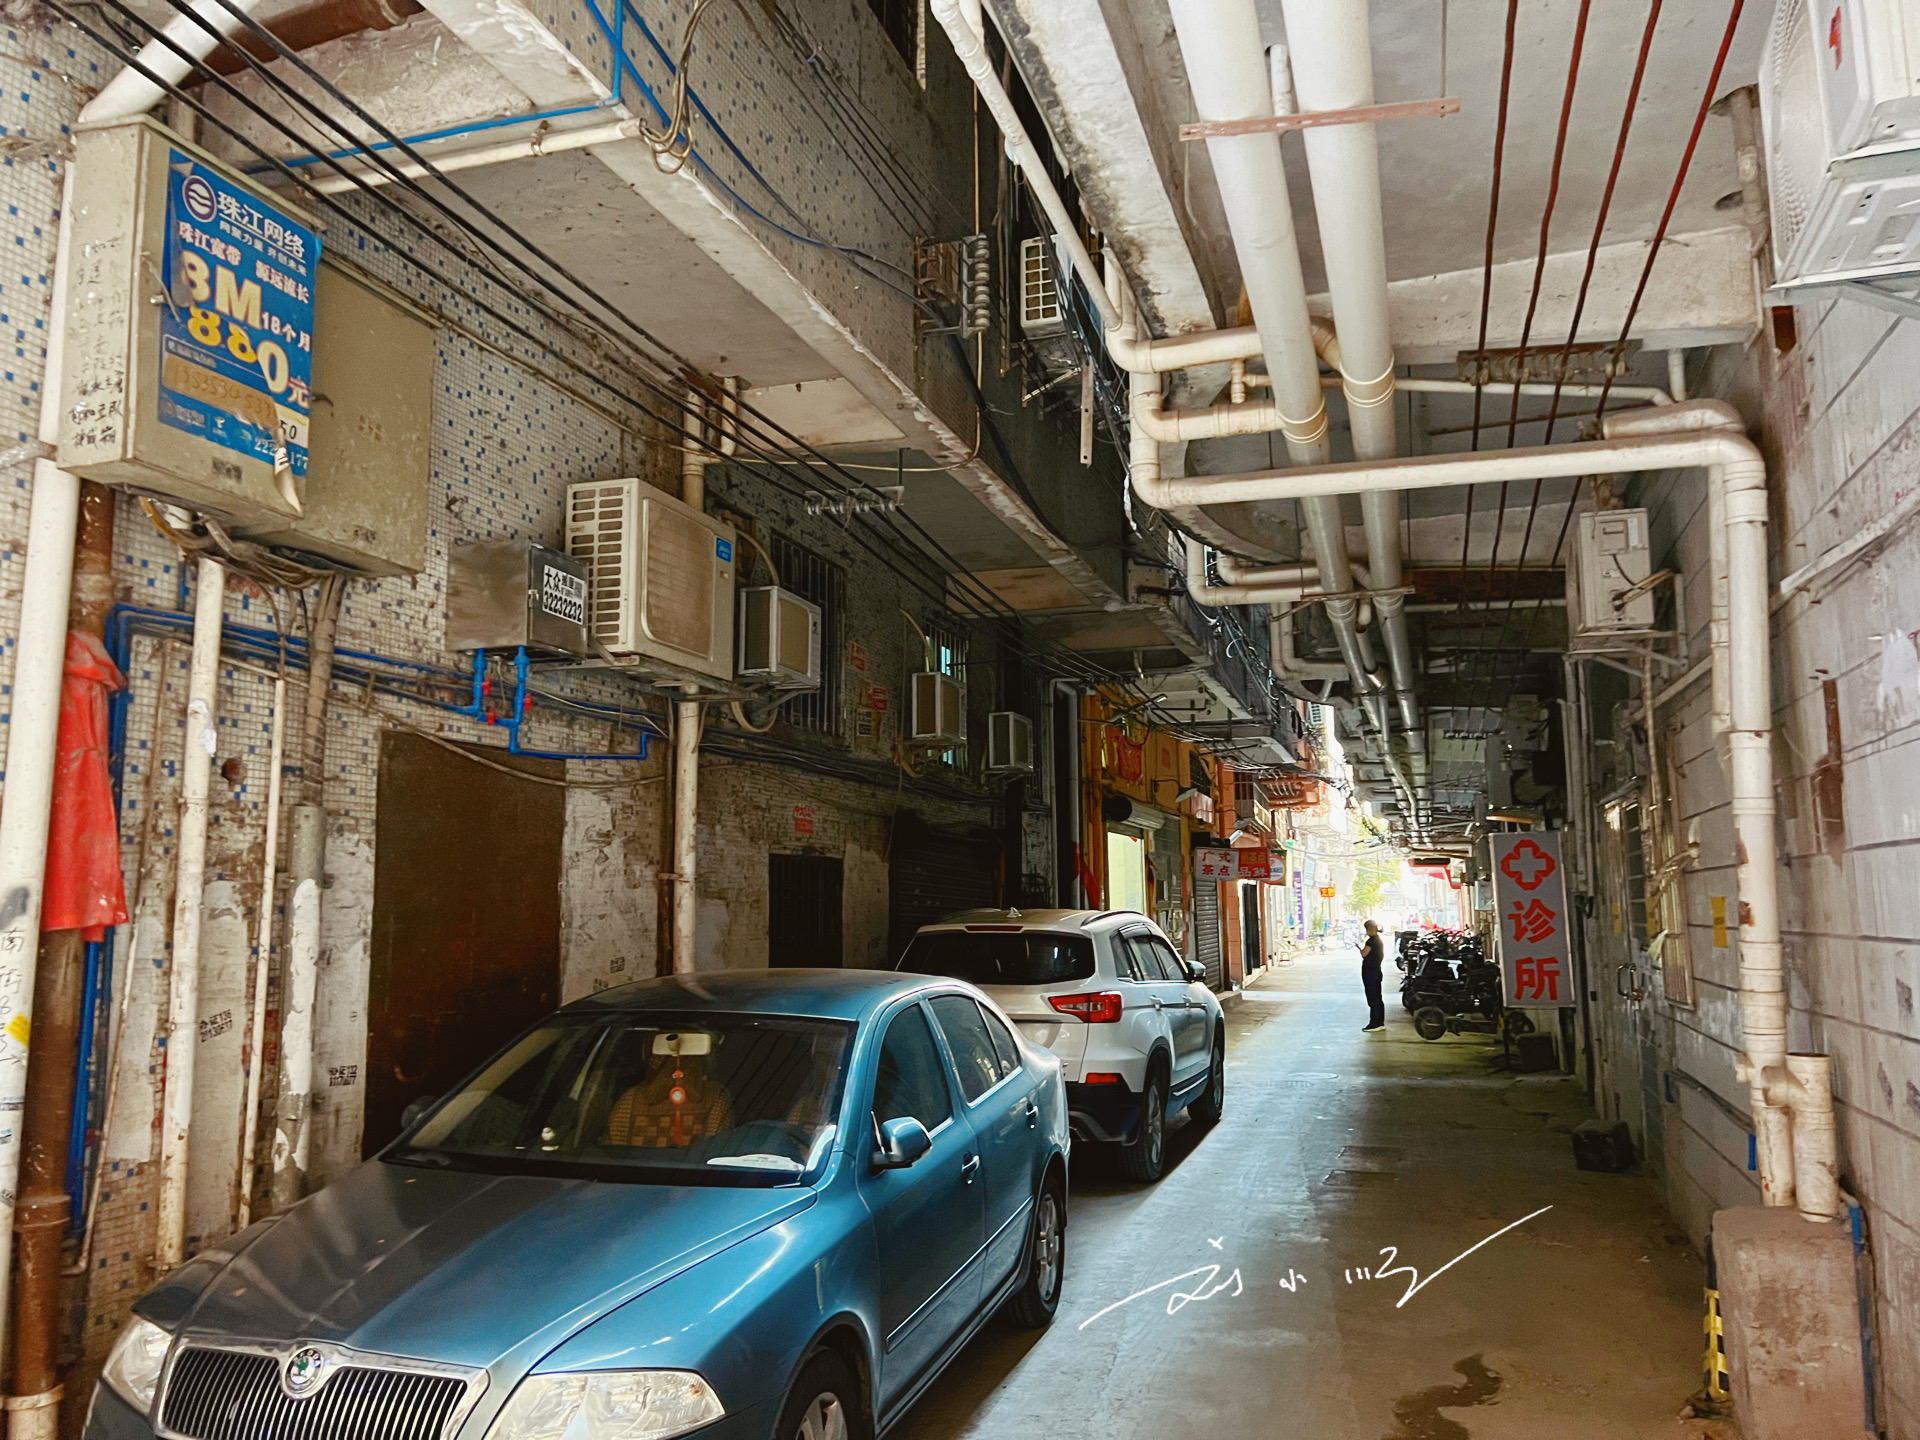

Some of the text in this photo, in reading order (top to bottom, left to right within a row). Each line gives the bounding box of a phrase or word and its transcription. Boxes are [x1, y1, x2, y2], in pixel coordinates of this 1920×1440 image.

[217, 191, 305, 258] 珠江网络
[1202, 851, 1231, 863] 广式
[1202, 864, 1231, 877] 茶点
[1507, 898, 1561, 1001] 诊所
